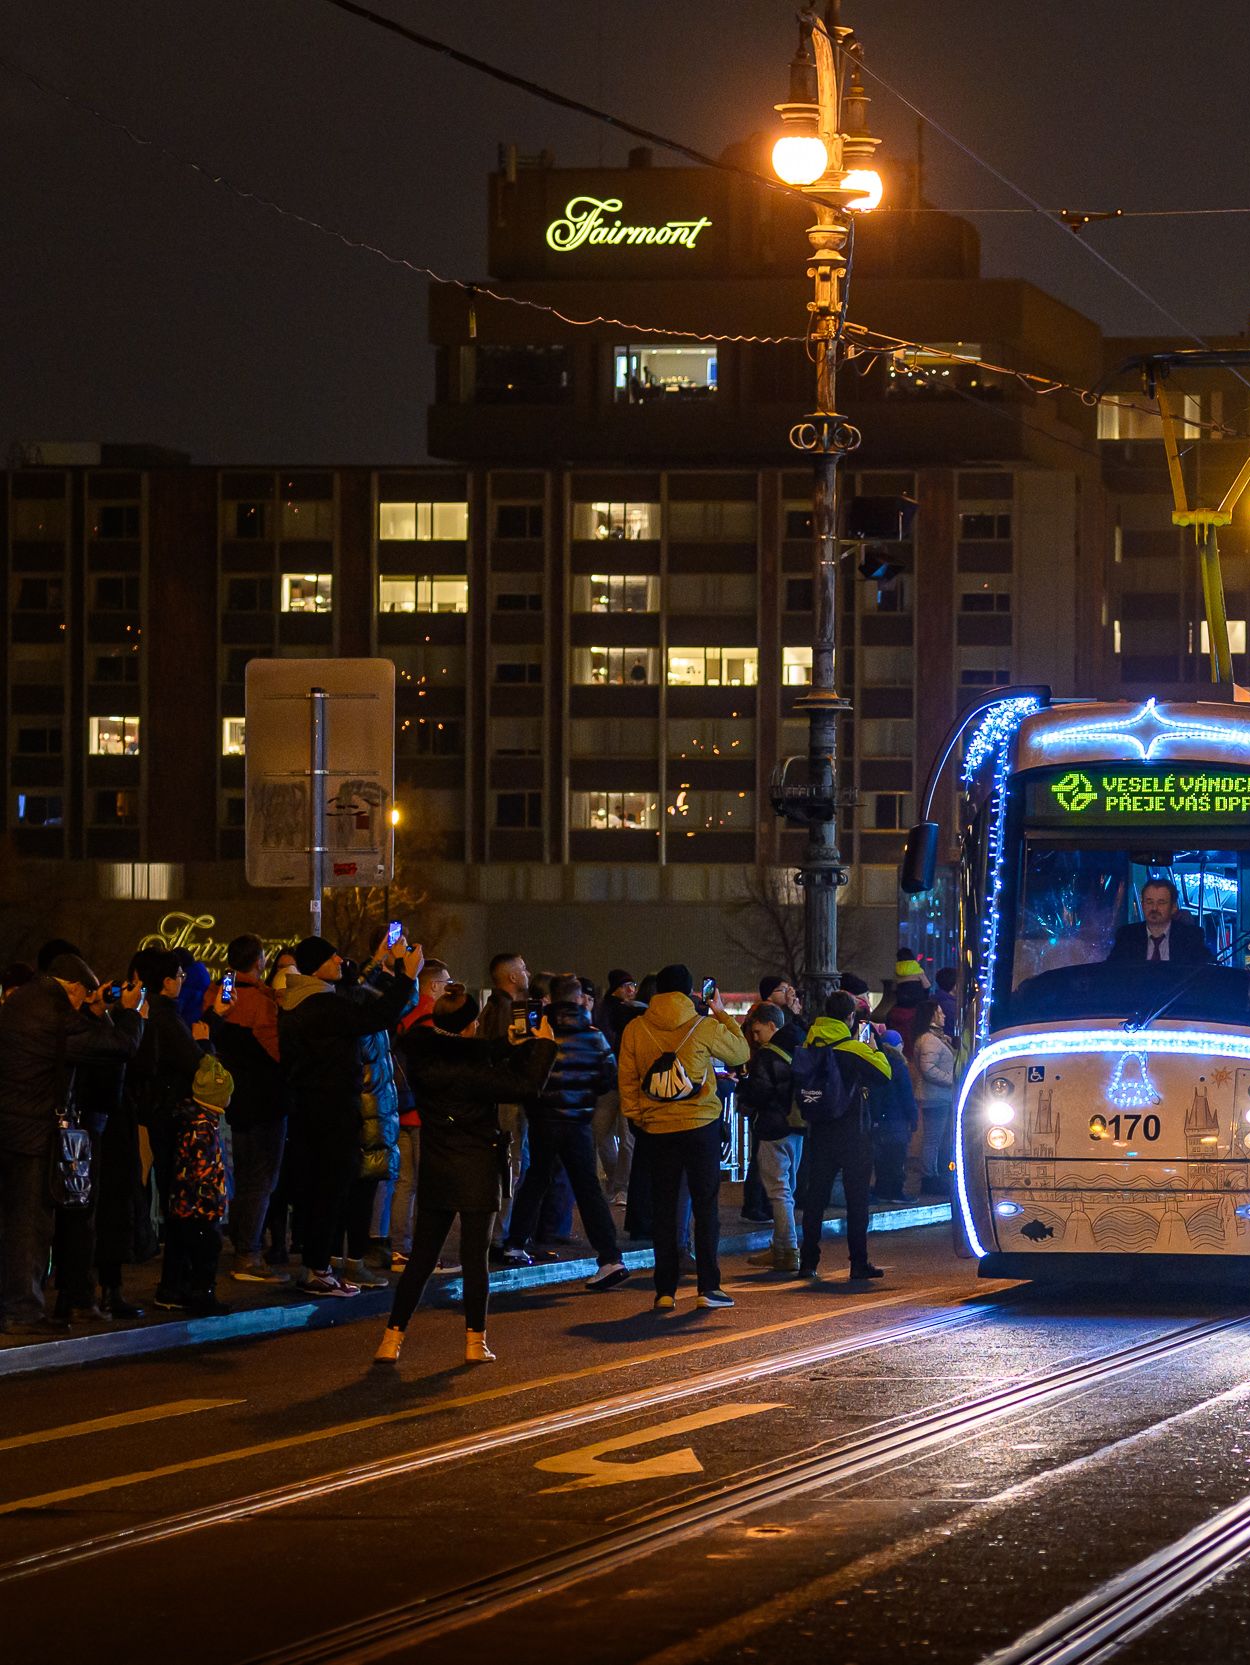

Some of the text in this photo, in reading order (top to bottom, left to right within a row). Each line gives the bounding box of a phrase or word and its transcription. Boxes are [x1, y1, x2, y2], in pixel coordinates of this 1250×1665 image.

[546, 196, 713, 252] Fairmont
[1102, 773, 1176, 792] VESELÉ
[1105, 793, 1166, 812] PŘEJE
[1169, 793, 1211, 812] VÁŠ
[1089, 1114, 1161, 1141] 9170
